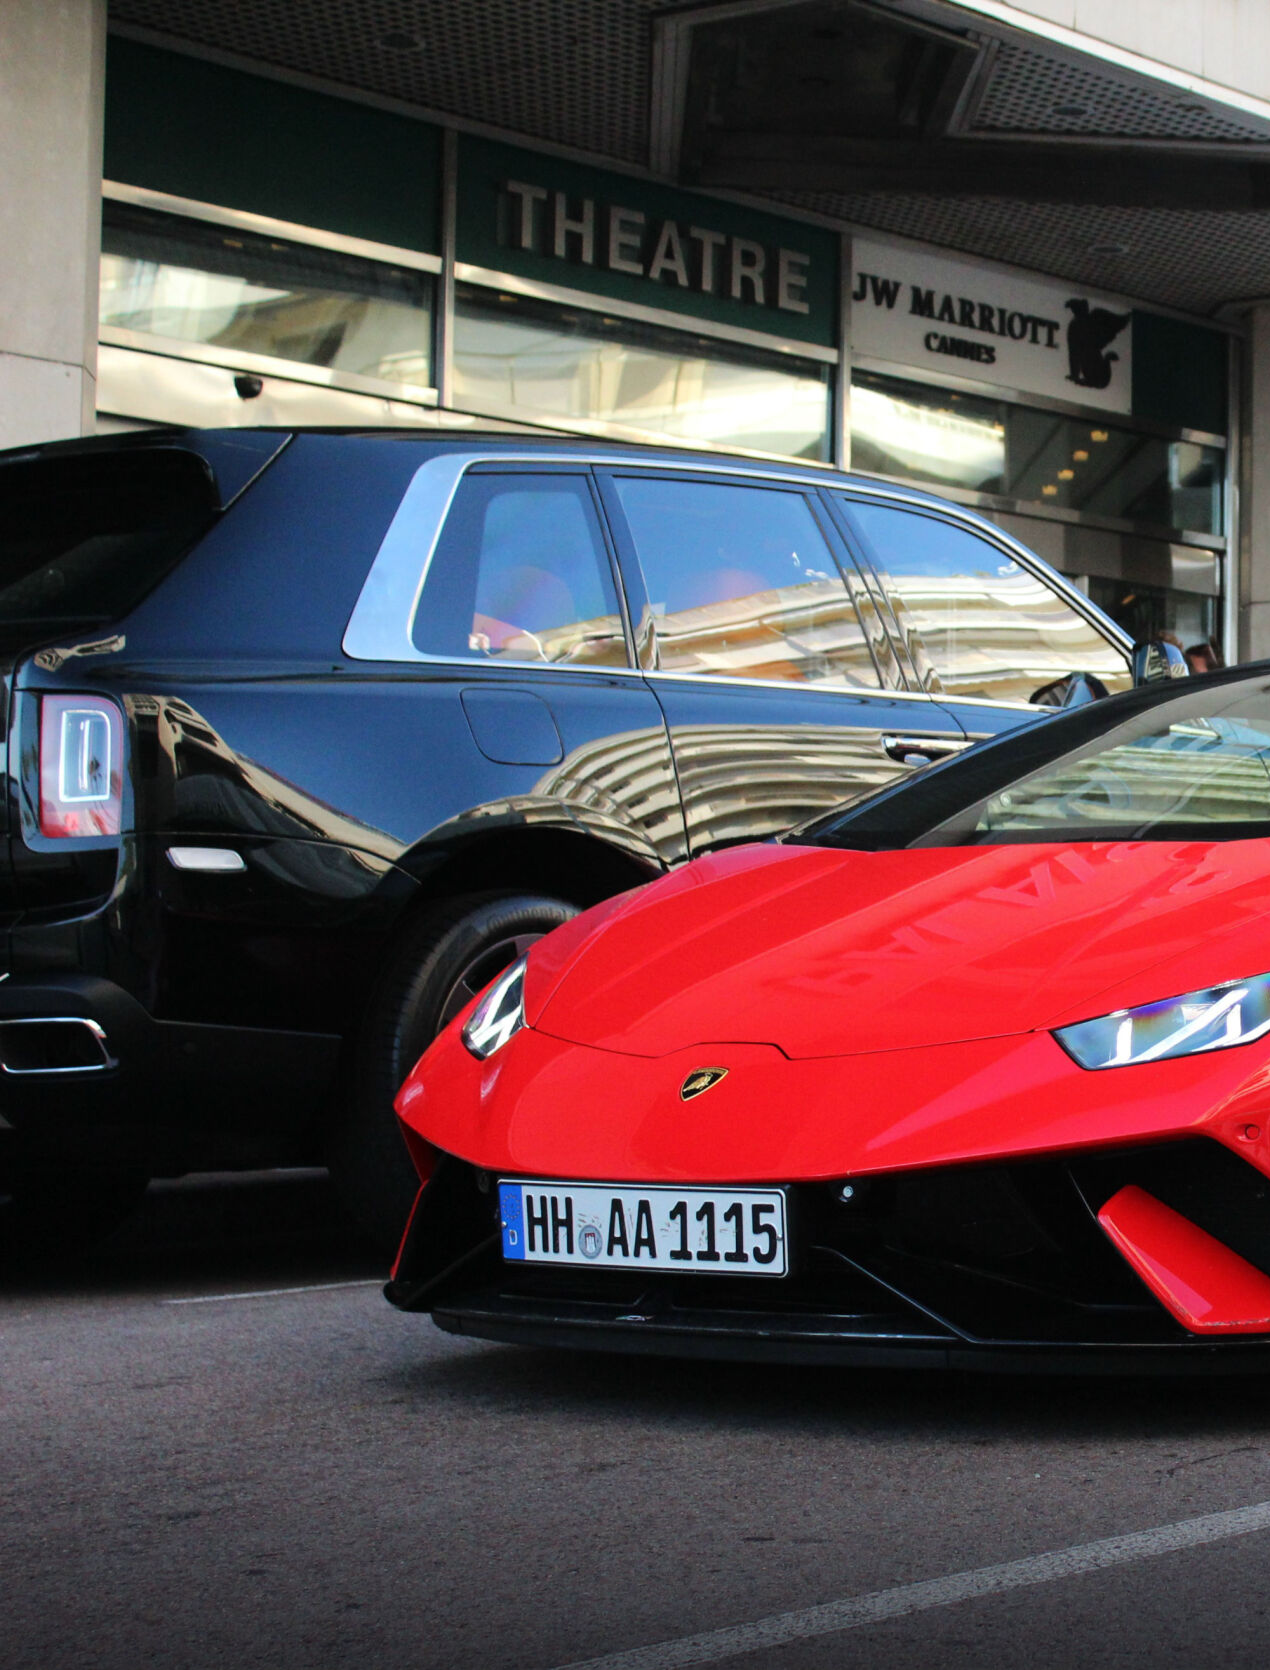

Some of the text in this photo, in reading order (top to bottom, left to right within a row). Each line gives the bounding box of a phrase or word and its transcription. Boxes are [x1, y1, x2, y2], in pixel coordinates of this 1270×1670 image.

[505, 179, 811, 315] THEATRE
[852, 272, 1061, 349] JW MARRIOTT
[924, 331, 997, 364] CANNES
[525, 1194, 574, 1255] HH
[606, 1197, 658, 1258] AA
[668, 1200, 778, 1265] 1115
